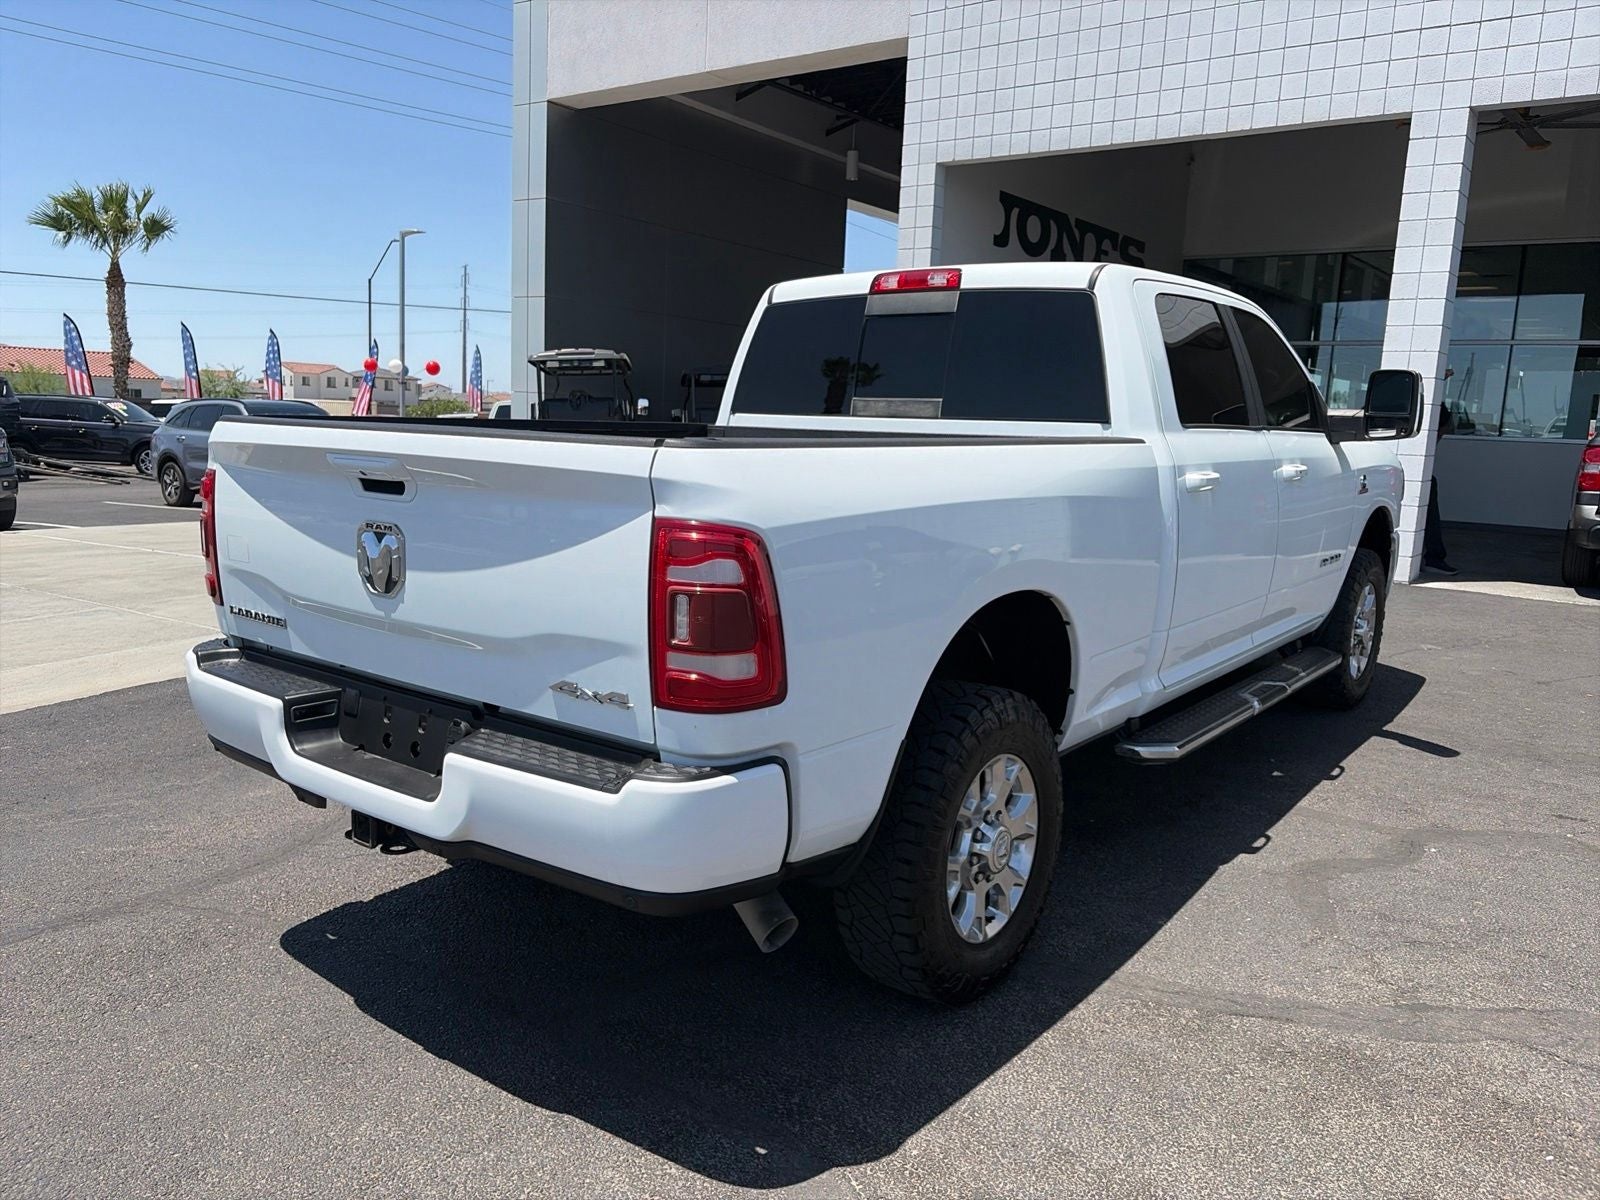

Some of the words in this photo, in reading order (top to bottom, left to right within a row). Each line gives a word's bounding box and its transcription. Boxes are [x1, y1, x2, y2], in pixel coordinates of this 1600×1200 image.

[993, 190, 1146, 268] JONES
[365, 522, 393, 533] RAM
[229, 605, 287, 629] LARAMIE
